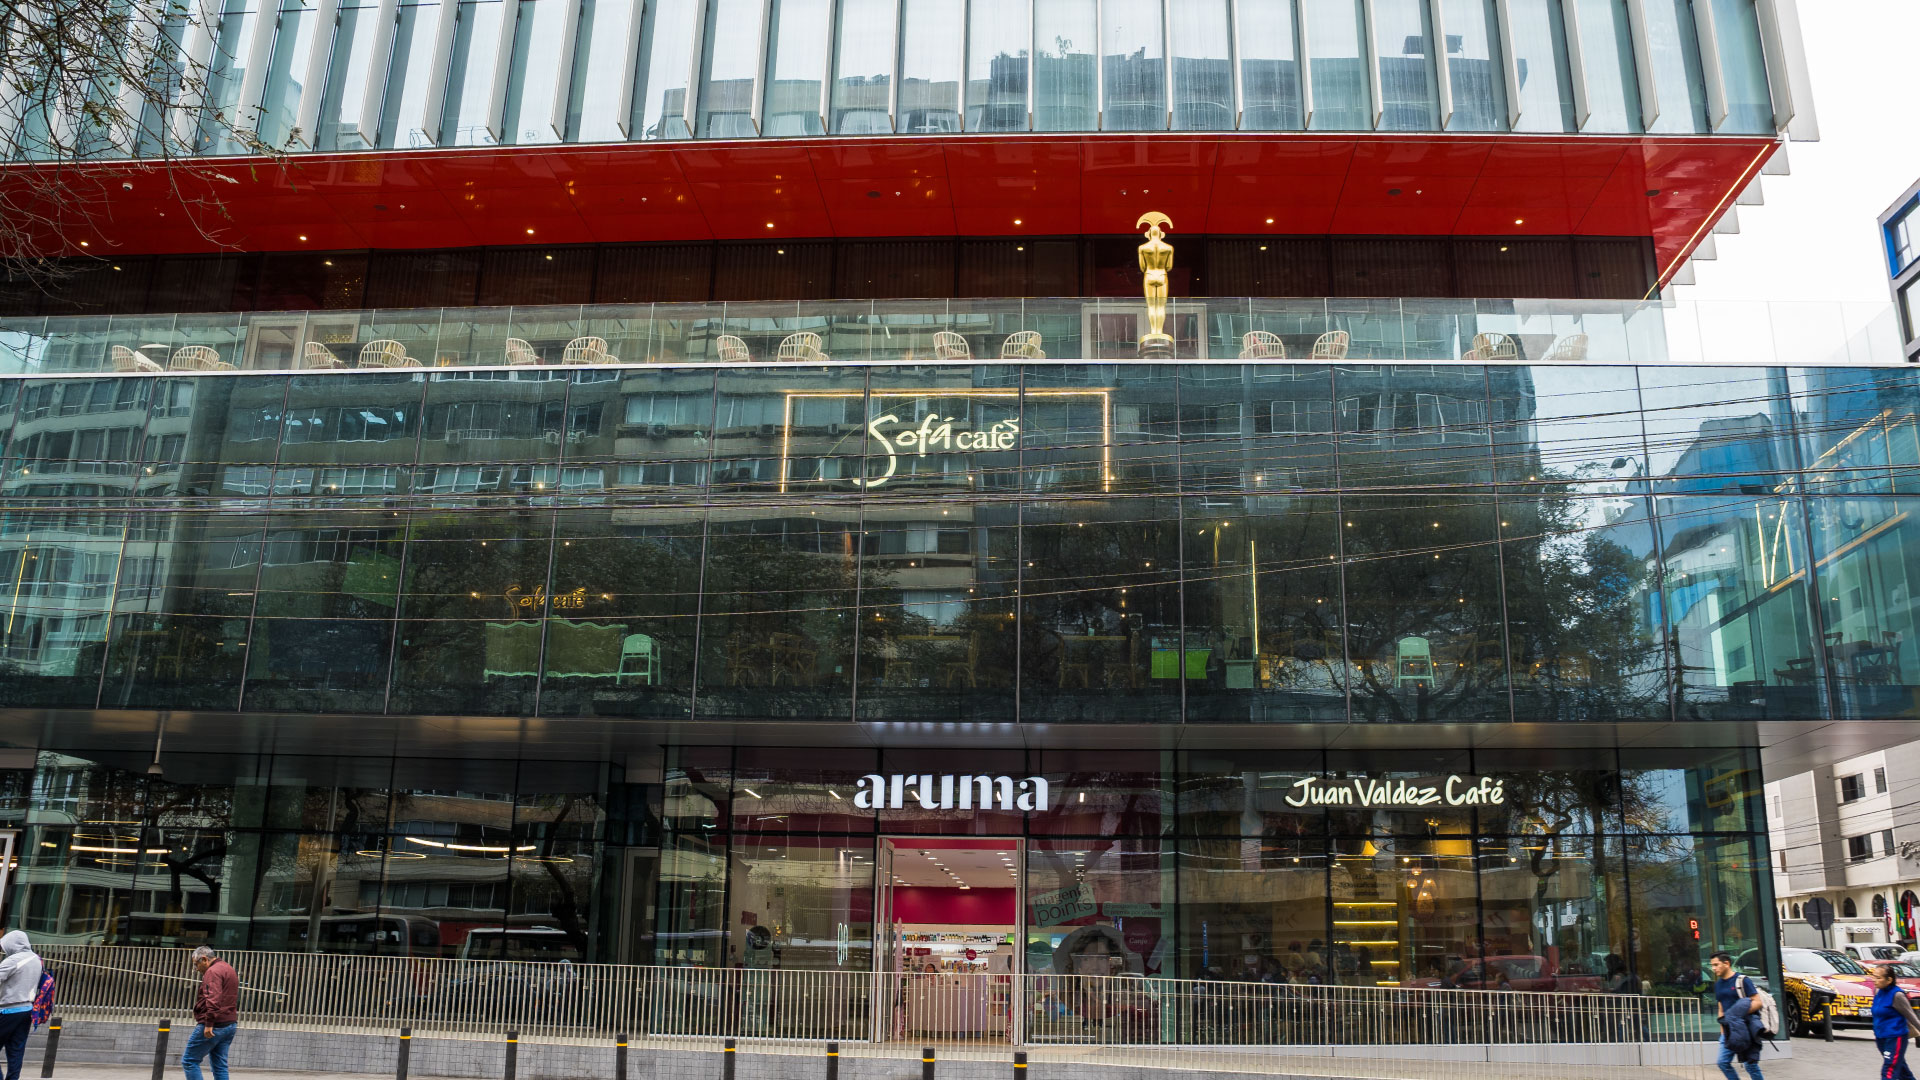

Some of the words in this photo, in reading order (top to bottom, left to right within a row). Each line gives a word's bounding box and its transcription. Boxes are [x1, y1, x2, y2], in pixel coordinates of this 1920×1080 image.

[852, 413, 955, 487] Sofá
[854, 774, 1048, 811] aruma
[1285, 776, 1353, 807] Juan
[1446, 774, 1505, 806] Café
[1034, 881, 1090, 909] magenta
[1037, 897, 1093, 927] points
